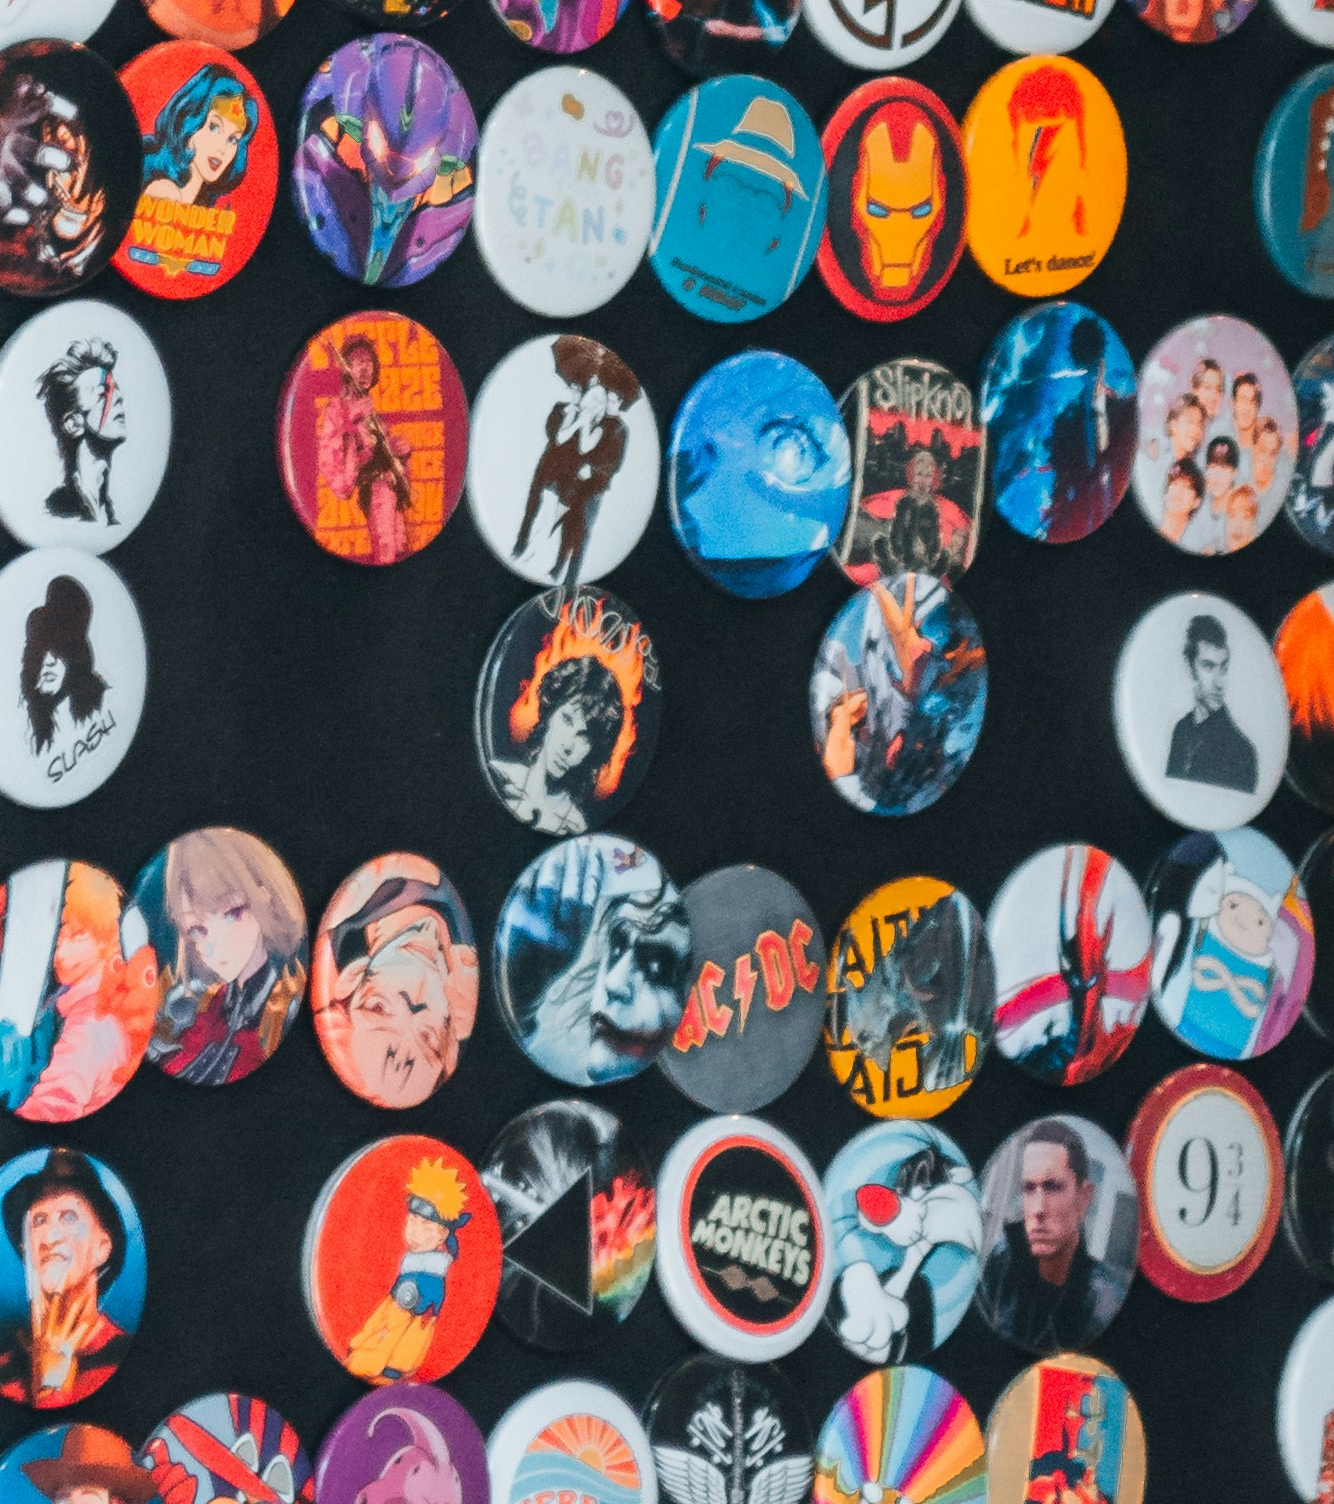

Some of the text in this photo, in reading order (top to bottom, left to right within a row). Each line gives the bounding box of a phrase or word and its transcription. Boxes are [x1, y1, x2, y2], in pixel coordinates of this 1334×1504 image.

[522, 133, 625, 192] BANG
[130, 218, 227, 259] WOMAN
[133, 194, 236, 235] WONDER
[533, 194, 606, 246] TAN
[46, 709, 116, 785] SLASH
[716, 1194, 810, 1248] ARCTIC
[692, 1217, 810, 1288] MONKEYS
